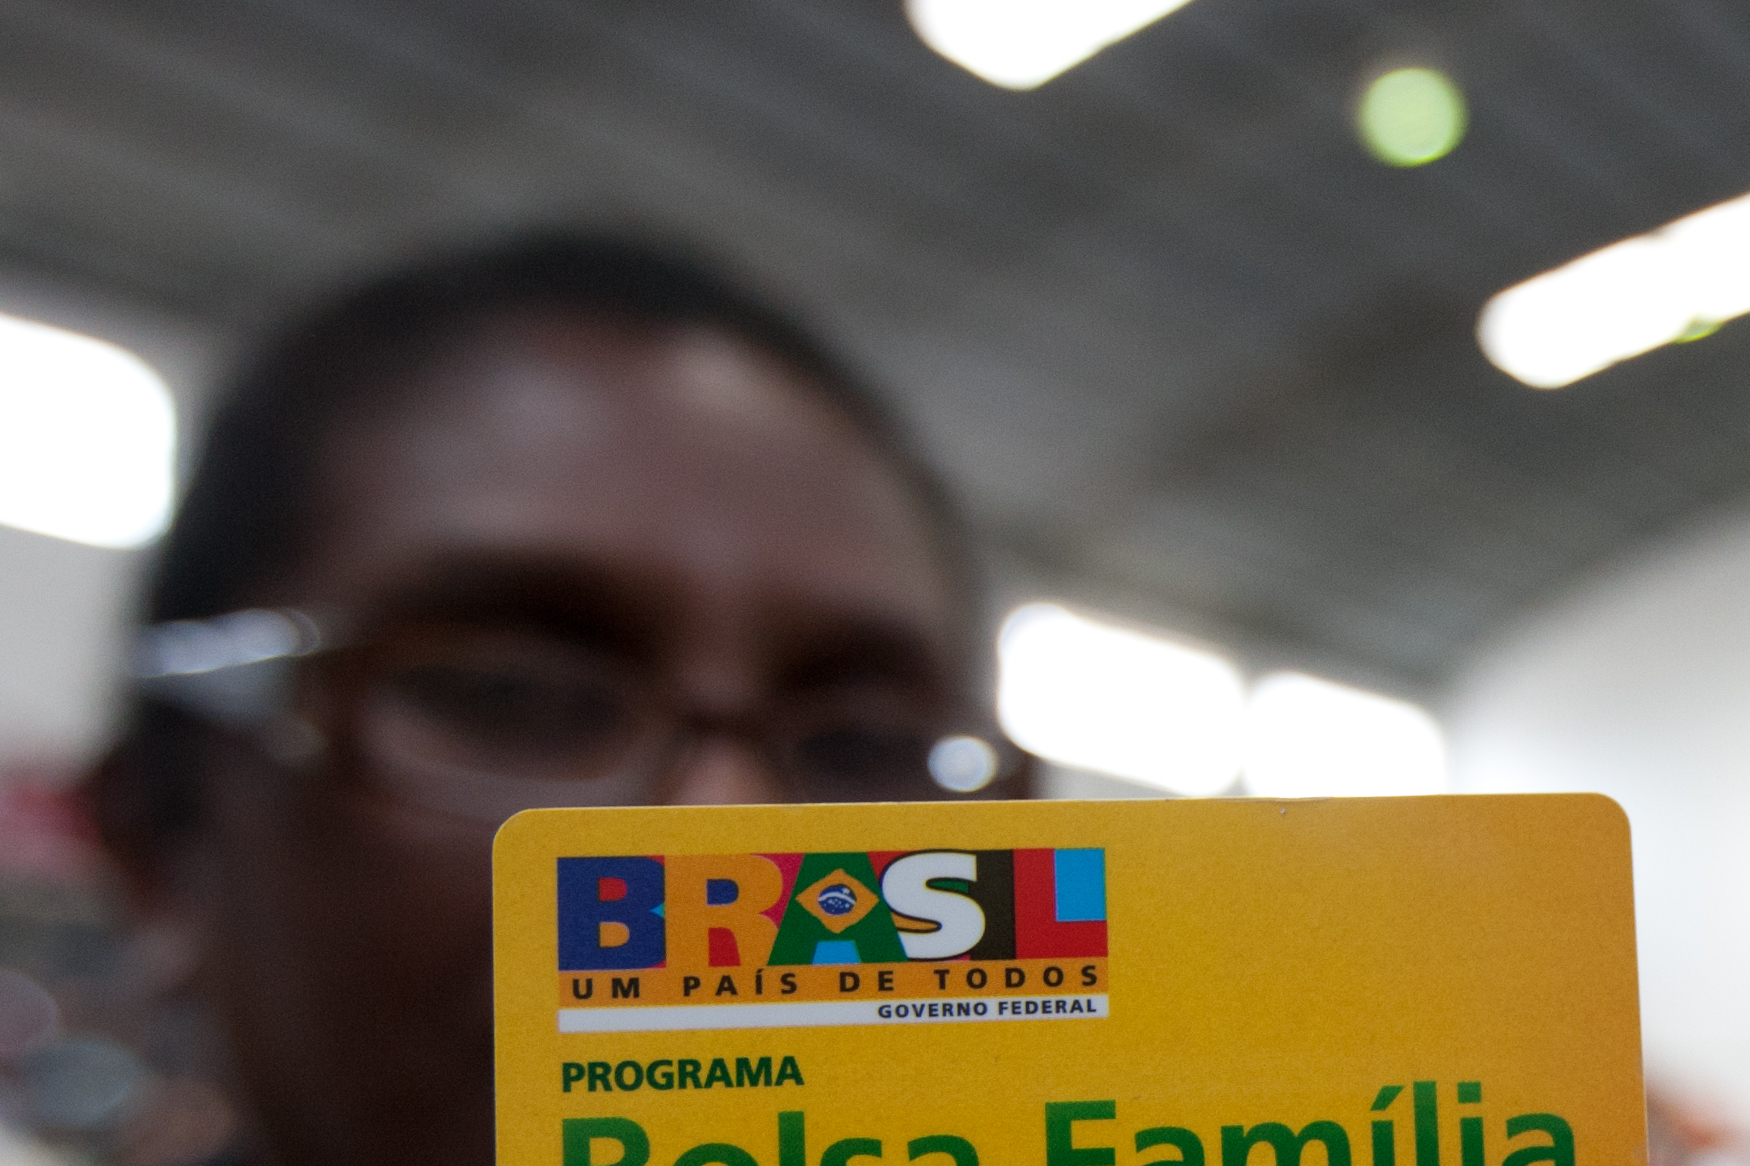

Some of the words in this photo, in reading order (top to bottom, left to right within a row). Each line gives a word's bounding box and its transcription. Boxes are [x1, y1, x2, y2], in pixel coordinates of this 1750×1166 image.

[557, 848, 1108, 970] BRASIL
[572, 976, 641, 1000] UM
[683, 968, 798, 997] PAÍS
[839, 970, 895, 993] DE
[933, 964, 1098, 991] TODOS
[877, 1001, 989, 1019] GOVERNO
[998, 998, 1097, 1016] FEDERAL
[561, 1055, 805, 1094] PROGRAMA
